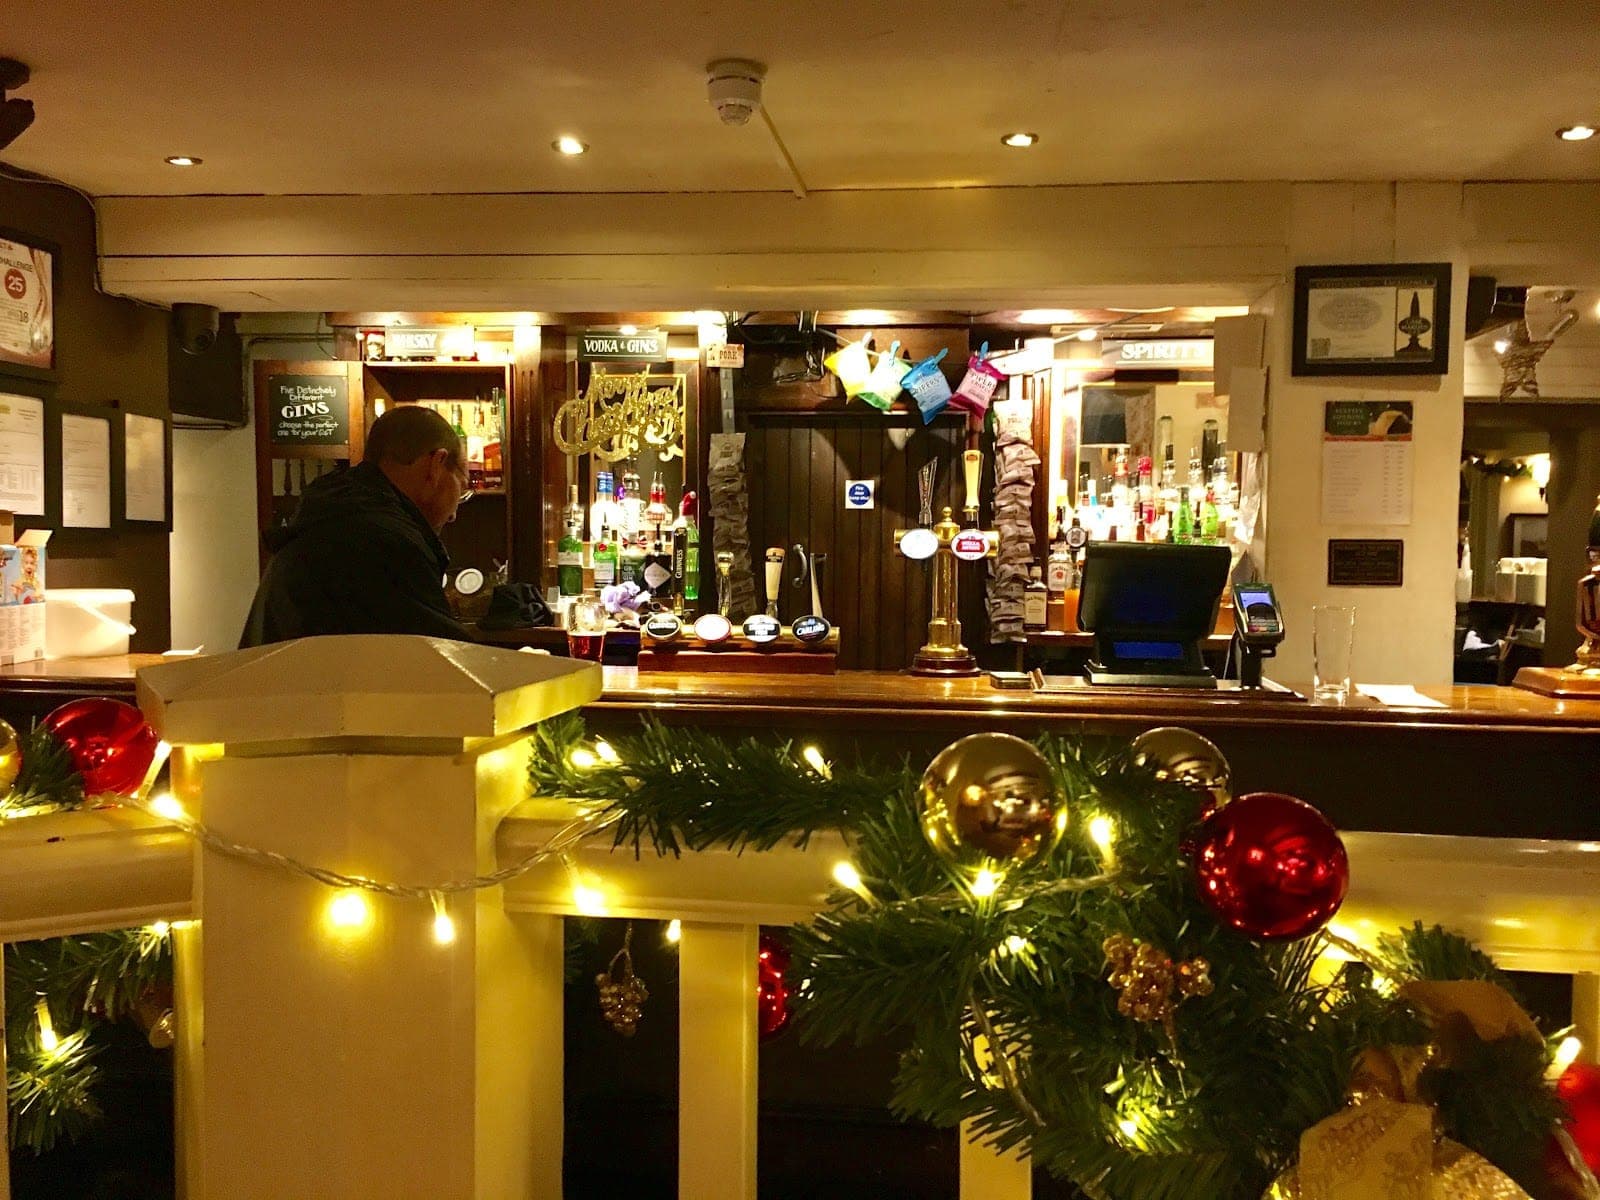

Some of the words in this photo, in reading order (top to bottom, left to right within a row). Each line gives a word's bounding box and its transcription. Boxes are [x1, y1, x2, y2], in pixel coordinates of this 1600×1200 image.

[8, 275, 24, 292] 25
[584, 340, 619, 353] VODKA
[627, 340, 659, 353] GINS
[281, 401, 330, 419] GINS
[675, 549, 683, 579] GUINNESS
